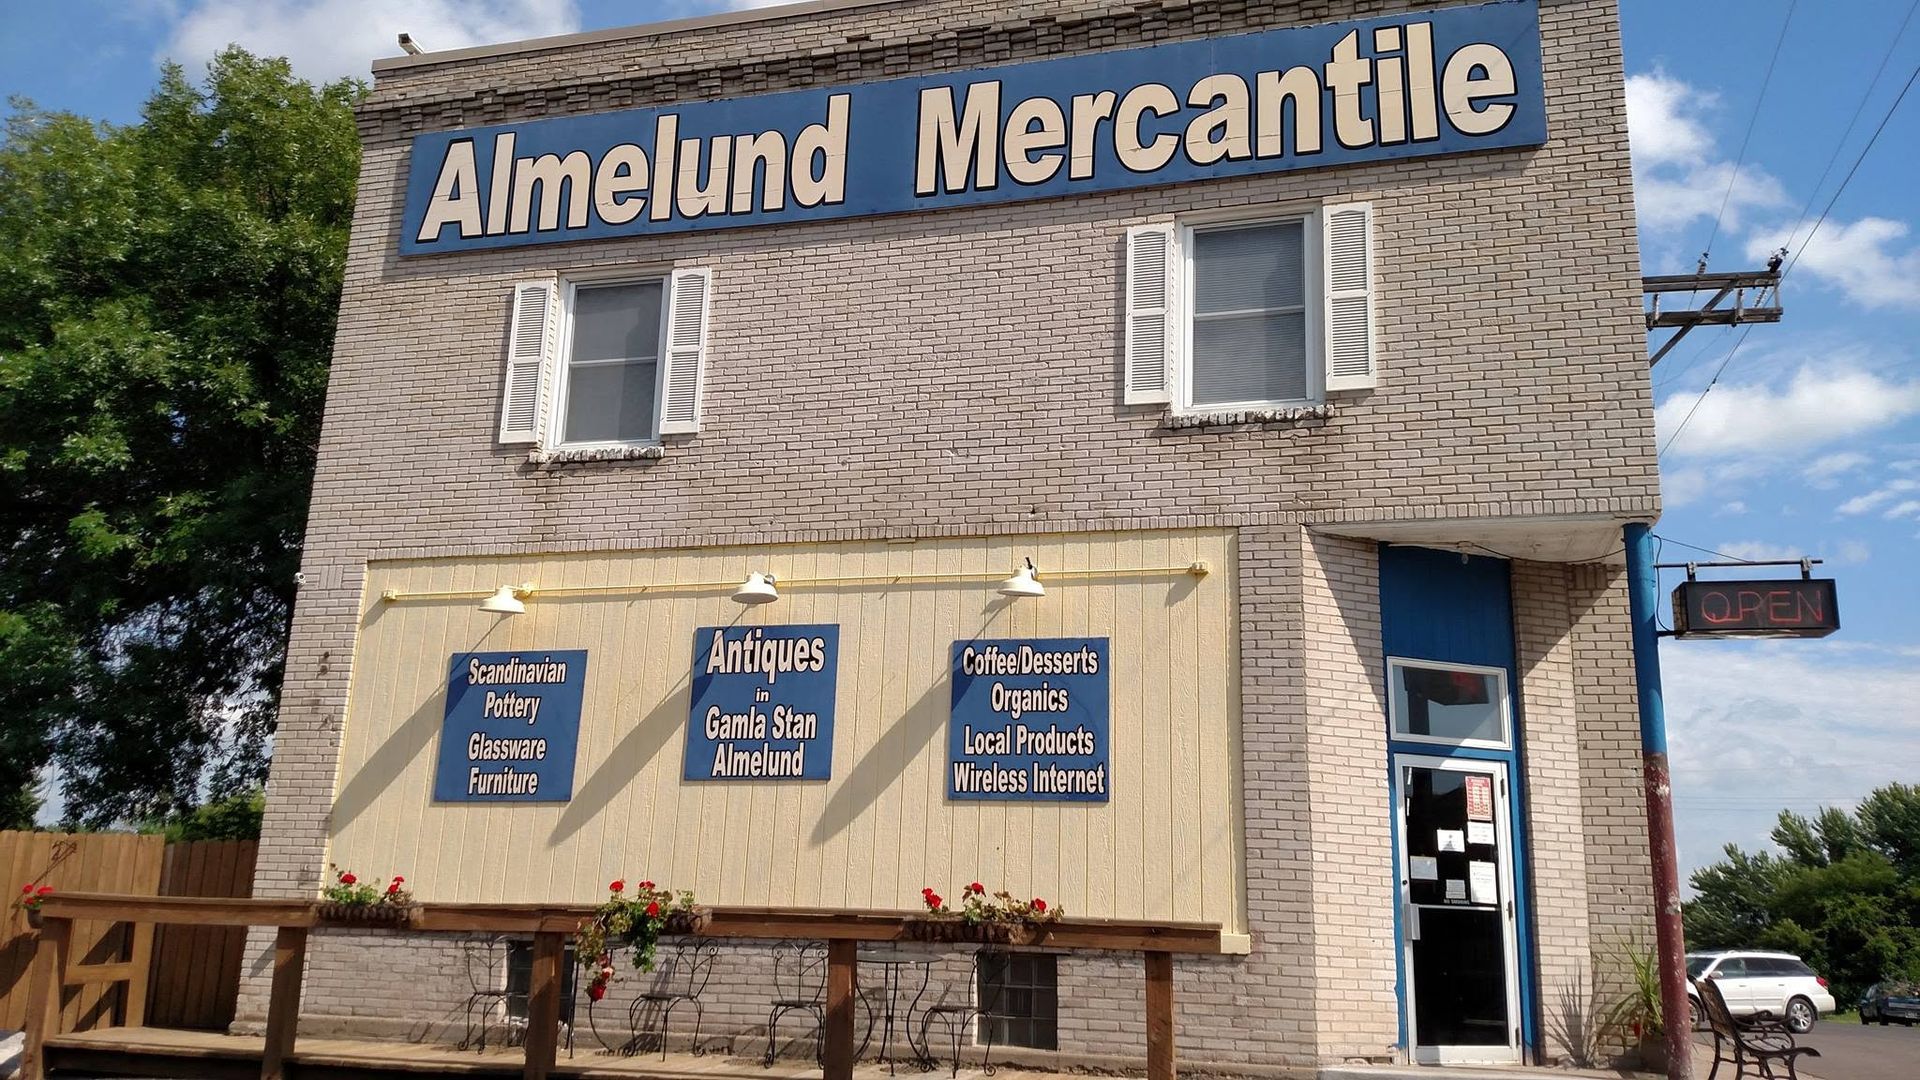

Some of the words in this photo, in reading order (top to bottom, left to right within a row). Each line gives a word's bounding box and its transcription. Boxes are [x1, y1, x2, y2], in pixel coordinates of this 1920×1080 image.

[416, 93, 851, 243] Almelund
[914, 20, 1517, 197] Mercantile
[1701, 590, 1823, 623] OPEN
[468, 656, 567, 685] Scandinavian
[706, 628, 825, 684] Antiques
[963, 645, 1098, 675] Coffee/Desserts
[483, 690, 540, 724] Pottery
[755, 687, 770, 702] in
[991, 682, 1068, 719] Organics
[705, 705, 766, 740] Gamla
[772, 705, 817, 740] Stan
[468, 732, 547, 760] Glassware
[964, 725, 1011, 755] Local
[1016, 724, 1094, 755] Products
[711, 742, 805, 777] Almelund
[468, 766, 538, 795] Furniture
[953, 762, 1028, 793] Wireless
[1032, 762, 1105, 793] Internet
